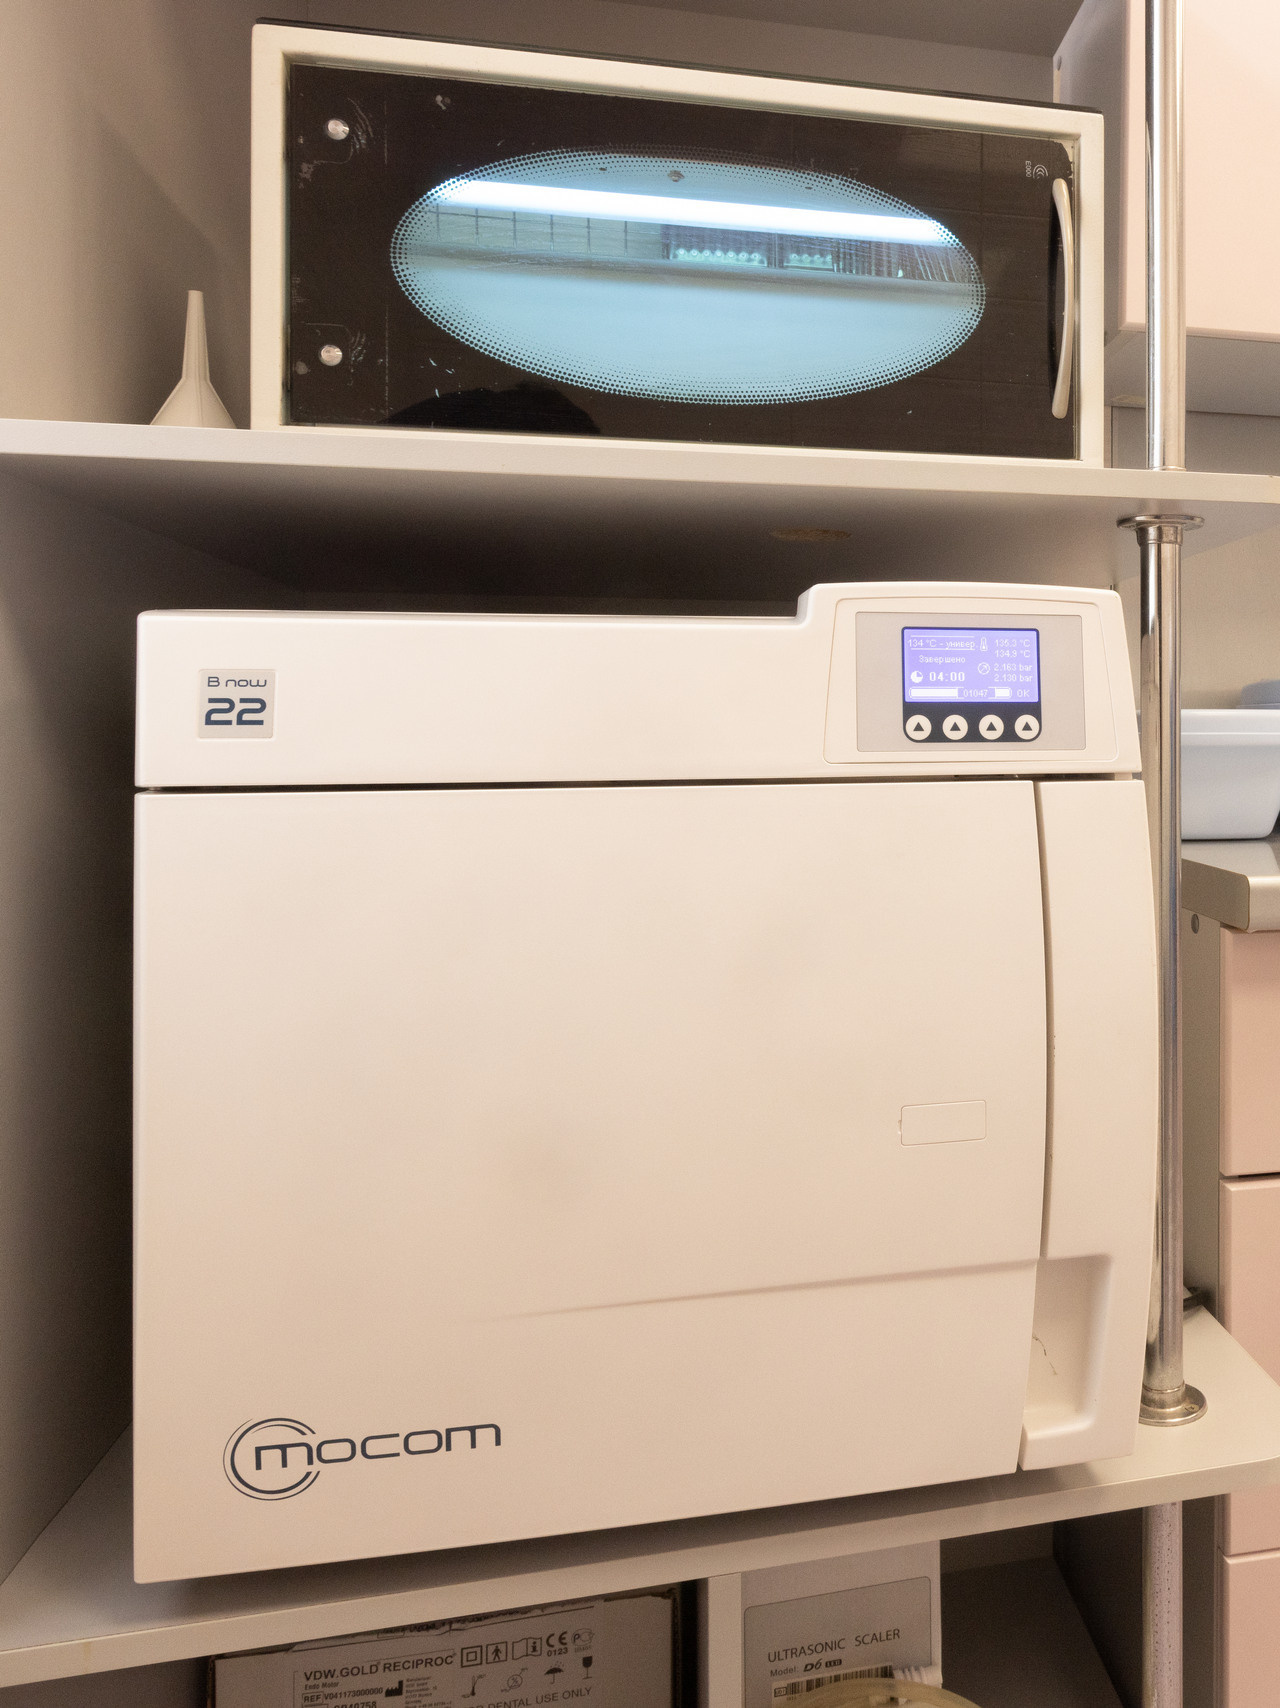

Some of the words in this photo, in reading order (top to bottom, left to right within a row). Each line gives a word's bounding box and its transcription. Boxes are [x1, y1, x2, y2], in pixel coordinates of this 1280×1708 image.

[907, 639, 924, 648] 134
[918, 654, 967, 664] Завершено
[1019, 663, 1033, 672] bar
[207, 676, 220, 688] B
[225, 679, 267, 688] now
[929, 671, 966, 682] 04:00
[1019, 673, 1033, 682] bar
[963, 689, 988, 698] 01047
[1017, 689, 1030, 698] OK
[204, 697, 267, 726] 22
[254, 1423, 501, 1471] mocom
[768, 1637, 846, 1663] ULTRASONIC
[854, 1628, 901, 1647] SCALER
[546, 1646, 569, 1657] 0123
[769, 1665, 799, 1678] Model:
[803, 1658, 822, 1672] D6
[303, 1693, 322, 1703] REF
[535, 1691, 560, 1705] USE
[561, 1686, 592, 1700] ONLY
